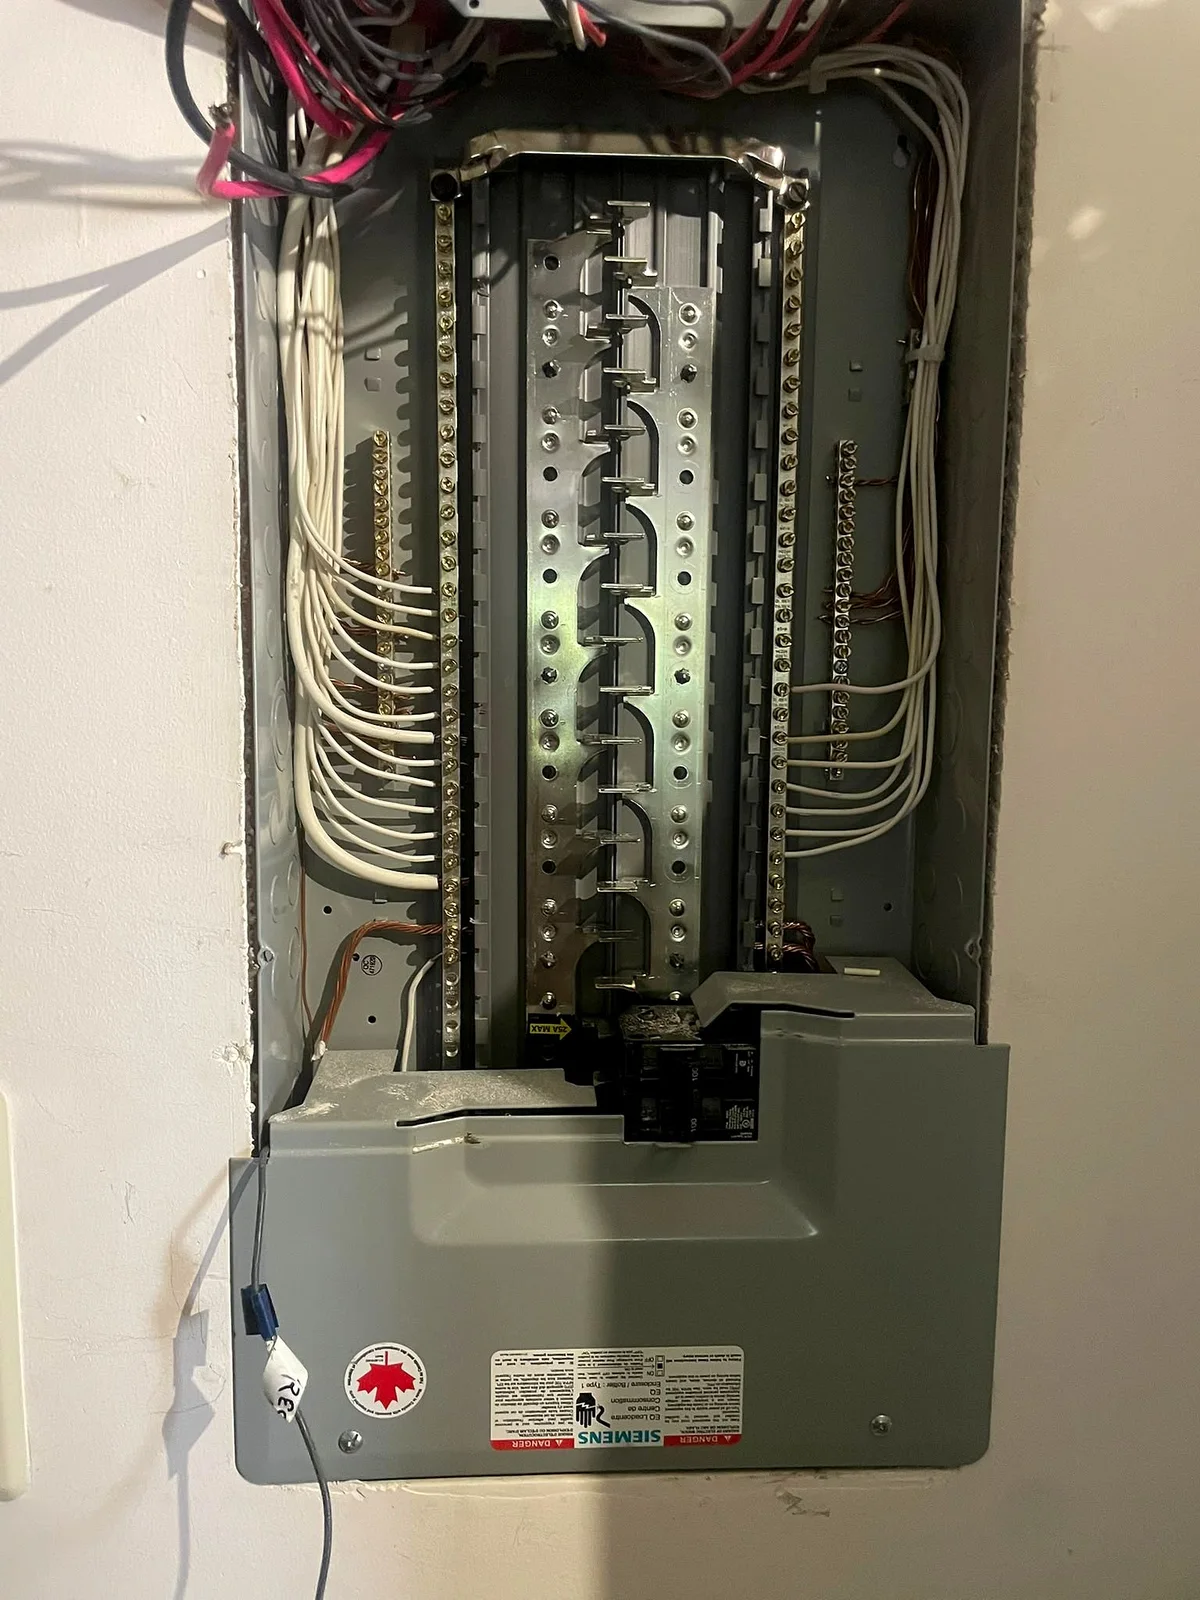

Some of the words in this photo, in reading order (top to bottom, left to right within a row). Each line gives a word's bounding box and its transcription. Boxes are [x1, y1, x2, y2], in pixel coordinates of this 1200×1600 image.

[531, 1025, 551, 1033] MAX
[690, 1118, 698, 1132] 100
[650, 1413, 661, 1421] EQ
[578, 1430, 661, 1444] SIEMENS
[680, 1435, 718, 1443] DANGER
[511, 1439, 551, 1448] DANGER
